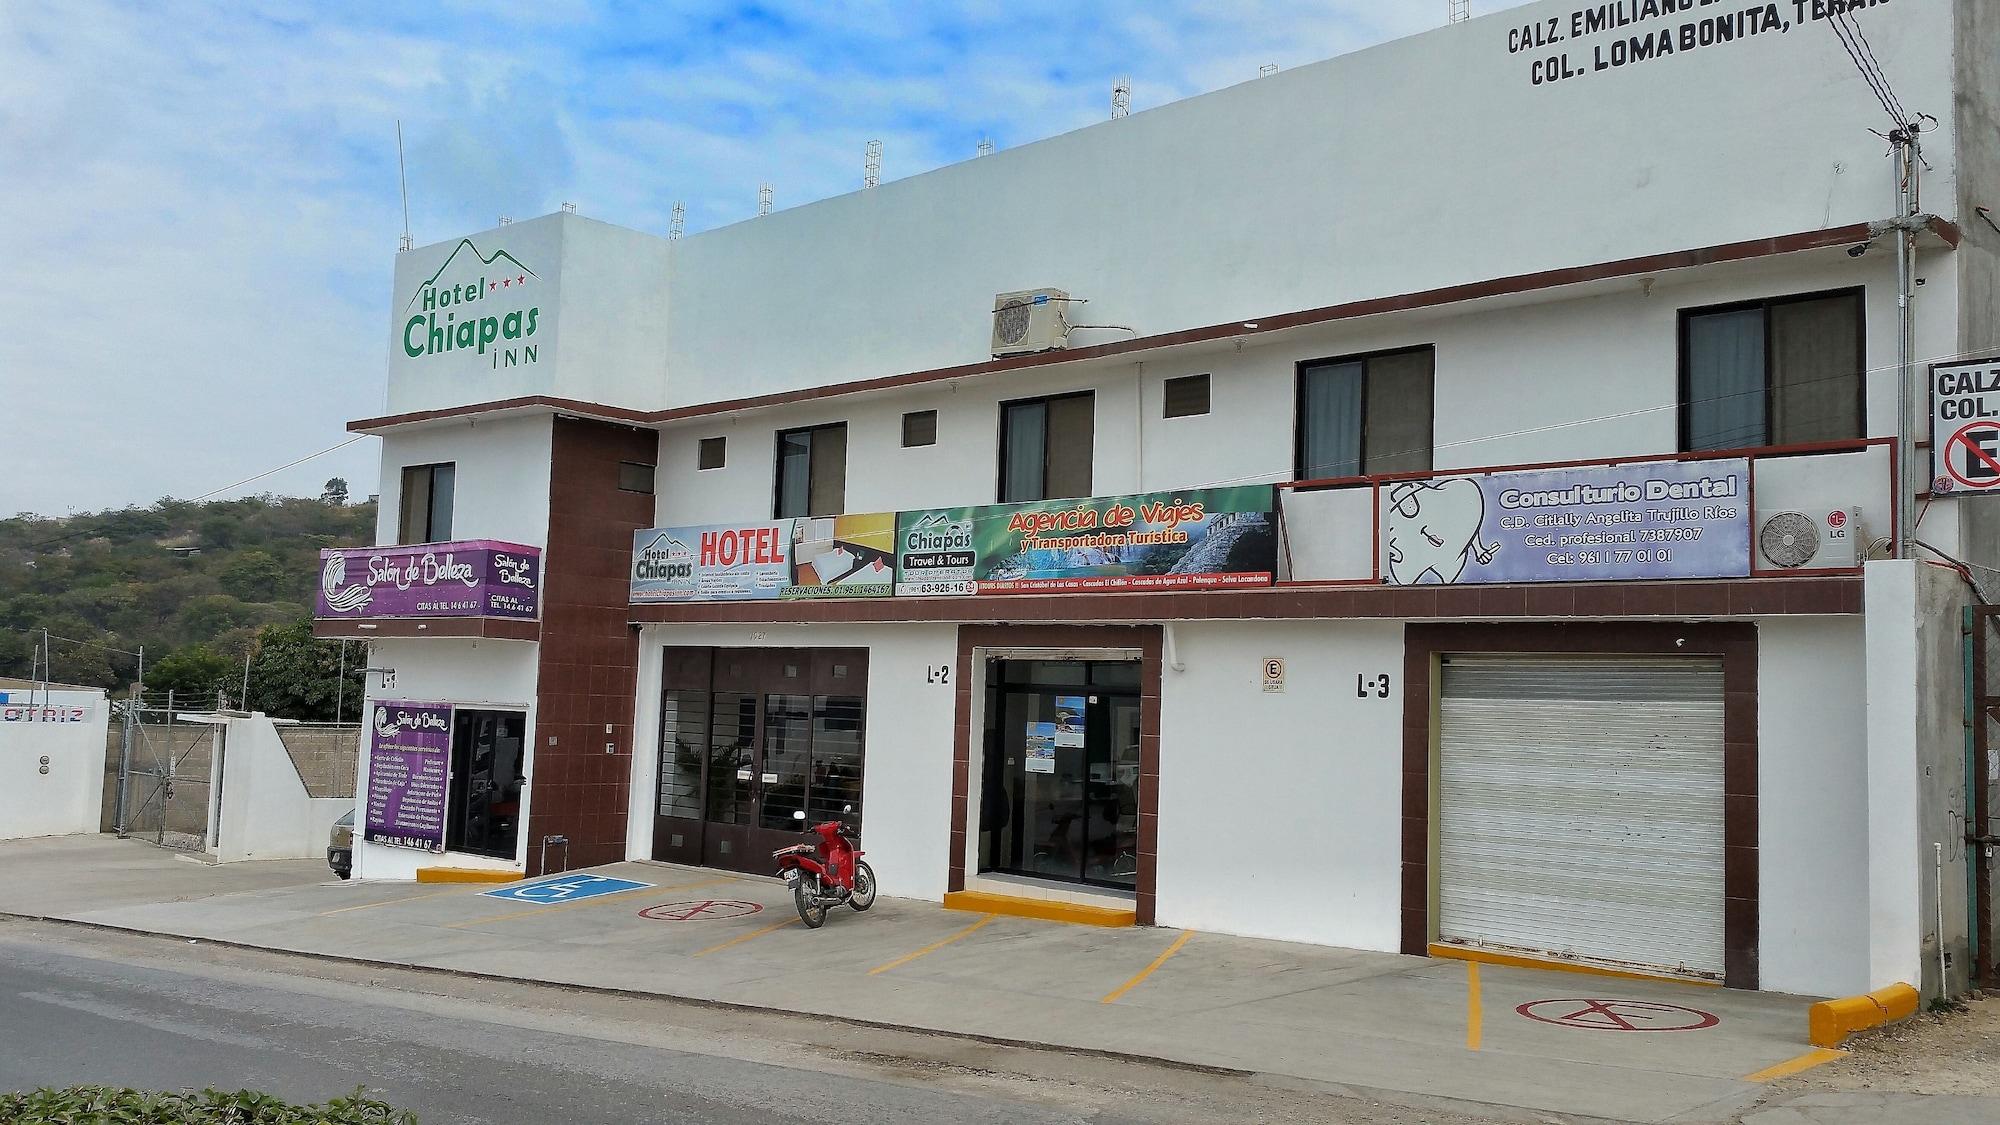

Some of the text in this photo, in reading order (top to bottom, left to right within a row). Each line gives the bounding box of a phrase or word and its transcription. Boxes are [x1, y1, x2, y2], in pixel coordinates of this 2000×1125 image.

[1508, 17, 1565, 54] CALZ.
[1532, 54, 1584, 85] COL.
[1594, 29, 1674, 71] LOMA
[1679, 3, 1790, 51] BONITA,
[423, 277, 485, 312] Hotel
[404, 307, 539, 358] Chiapas
[1941, 397, 1999, 420] COL.
[1499, 475, 1737, 509] Consulturio Dental
[1008, 499, 1205, 538] Agencia de Viajes
[1500, 505, 1737, 528] C.D. Citlally Angelita Trujillo Ríos
[908, 532, 970, 551] Chiapas
[1021, 529, 1188, 554] y Transportadora Turística
[1525, 527, 1703, 547] Ced. profesional 7387907
[1830, 530, 1845, 538] LG
[645, 549, 669, 559] Hotel
[701, 528, 785, 567] HOTEL
[1547, 552, 1575, 564] Cel:
[1579, 551, 1600, 564] 961
[1614, 550, 1633, 563] 77
[494, 554, 530, 572] Salón de
[909, 555, 969, 566] Travel & Tours
[367, 553, 479, 590] Salón de Belleza
[500, 569, 535, 588] Belleza
[636, 560, 693, 582] Chiapas
[921, 583, 964, 593] 63-926-16
[416, 602, 432, 610] CITAS
[432, 602, 439, 610] AL
[470, 601, 478, 609] 67
[491, 595, 509, 603] CITAS
[1270, 663, 1277, 674] E
[414, 713, 421, 725] de
[422, 712, 448, 731] Belleza
[374, 834, 387, 843] CITAS
[424, 839, 432, 849] 67
